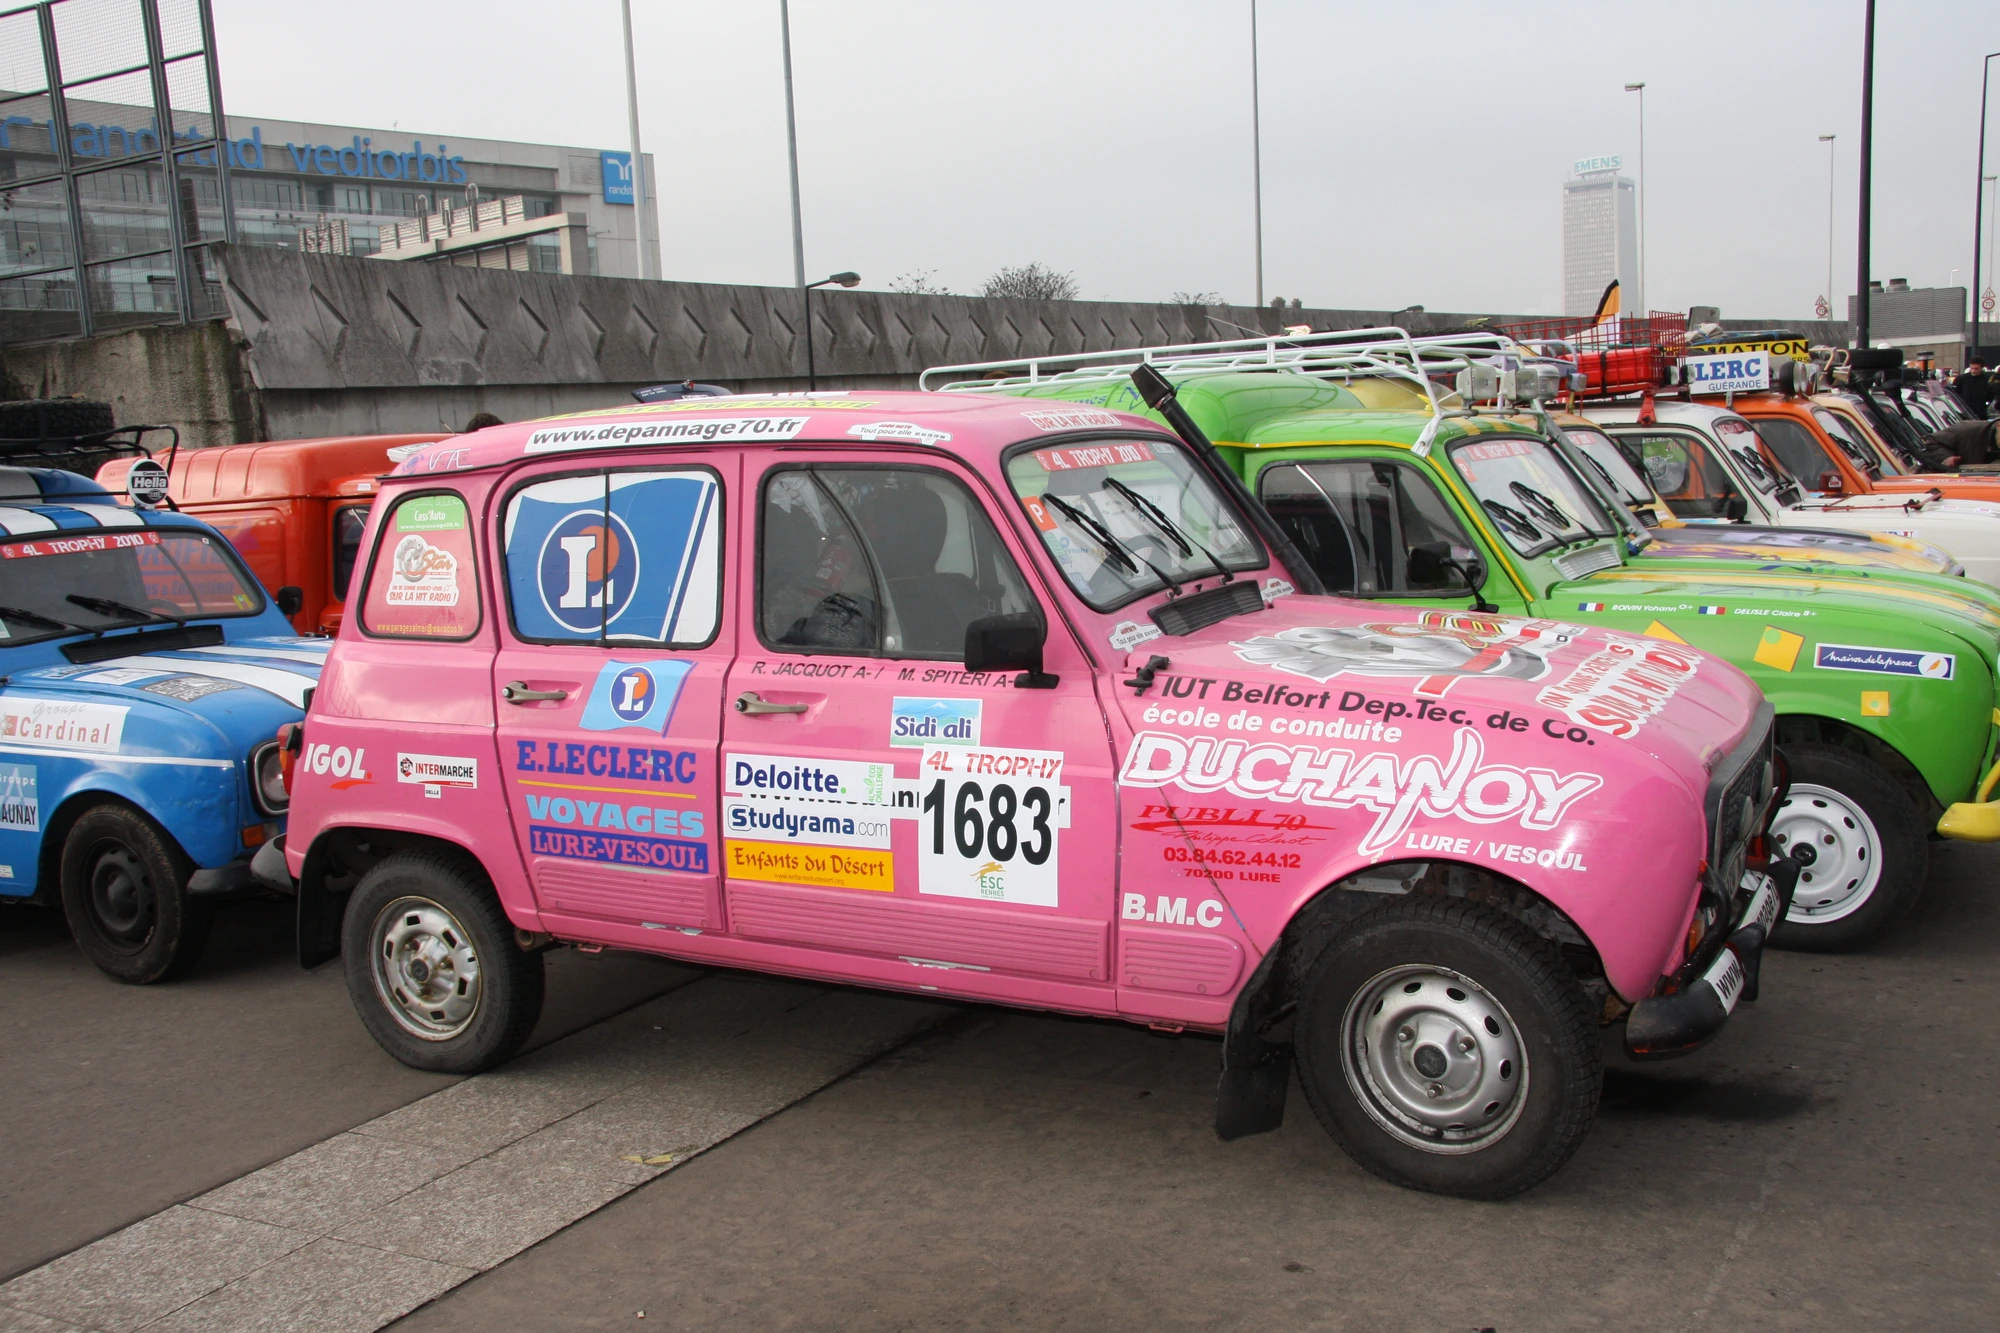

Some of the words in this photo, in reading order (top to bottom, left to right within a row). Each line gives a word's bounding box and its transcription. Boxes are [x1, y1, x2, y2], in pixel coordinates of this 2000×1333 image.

[286, 135, 468, 183] vediorbis
[1694, 358, 1762, 382] LERC
[1708, 379, 1762, 392] GUÉRANDE
[532, 418, 801, 445] www.depannage70.fr
[877, 428, 897, 436] pour
[1051, 451, 1071, 469] 4L
[1068, 447, 1115, 467] TROPHY
[1114, 445, 1142, 463] 2010
[133, 477, 167, 488] Hella
[414, 509, 446, 521] Cass'Auto
[1029, 502, 1045, 524] P
[22, 544, 43, 557] 4L
[49, 537, 106, 555] TROPHY
[113, 534, 145, 549] 2010
[422, 549, 453, 571] Star
[389, 591, 404, 601] SUR
[405, 592, 414, 601] LA
[415, 592, 428, 602] HIT
[429, 592, 452, 602] RADIO
[1734, 608, 1769, 616] DELISLE
[1771, 609, 1801, 618] Claire
[1822, 650, 1918, 670] maisondelapresse
[751, 661, 766, 675] R.
[772, 661, 852, 678] JACQUOT
[852, 665, 872, 679] A-
[898, 668, 915, 682] M.
[921, 669, 991, 687] SPITERI
[32, 701, 88, 725] Groupe
[1142, 702, 1219, 730] école
[1227, 708, 1261, 732] de
[1268, 712, 1403, 743] conduite
[1163, 676, 1217, 701] IUT
[1221, 679, 1331, 712] Belfort
[1349, 690, 1474, 726] Dep.Tec.
[1485, 711, 1530, 733] de
[1541, 718, 1596, 746] Co.
[20, 716, 111, 744] Cardinal
[894, 715, 937, 738] Sidi
[943, 717, 972, 739] ali
[517, 740, 697, 784] E.LECLERC
[868, 764, 876, 779] ECO
[926, 750, 954, 772] 4L
[965, 752, 1062, 779] TROPHY
[876, 765, 884, 803] CHALLENGE
[1120, 726, 1604, 856] DUCHANOY
[0, 802, 37, 826] AUNAY
[525, 794, 705, 839] VOYAGES
[731, 806, 888, 838] Studyrama.com
[924, 778, 1053, 866] 1683
[1272, 813, 1308, 831] 70
[534, 830, 704, 871] LURE-VESOUL
[734, 847, 799, 870] Enfants
[804, 854, 826, 872] du
[829, 852, 885, 877] Désert
[1163, 846, 1301, 869] 03.84.62.44.12
[1405, 831, 1469, 856] LURE
[1472, 838, 1487, 857] /
[1487, 840, 1588, 873] VESOUL
[774, 872, 845, 885] www.enfantsdudesert.org
[980, 876, 1004, 890] ESC
[1183, 868, 1234, 880] 70200
[1239, 871, 1281, 883] LURE
[980, 888, 1005, 897] RENNES
[1121, 892, 1224, 928] B.M.C
